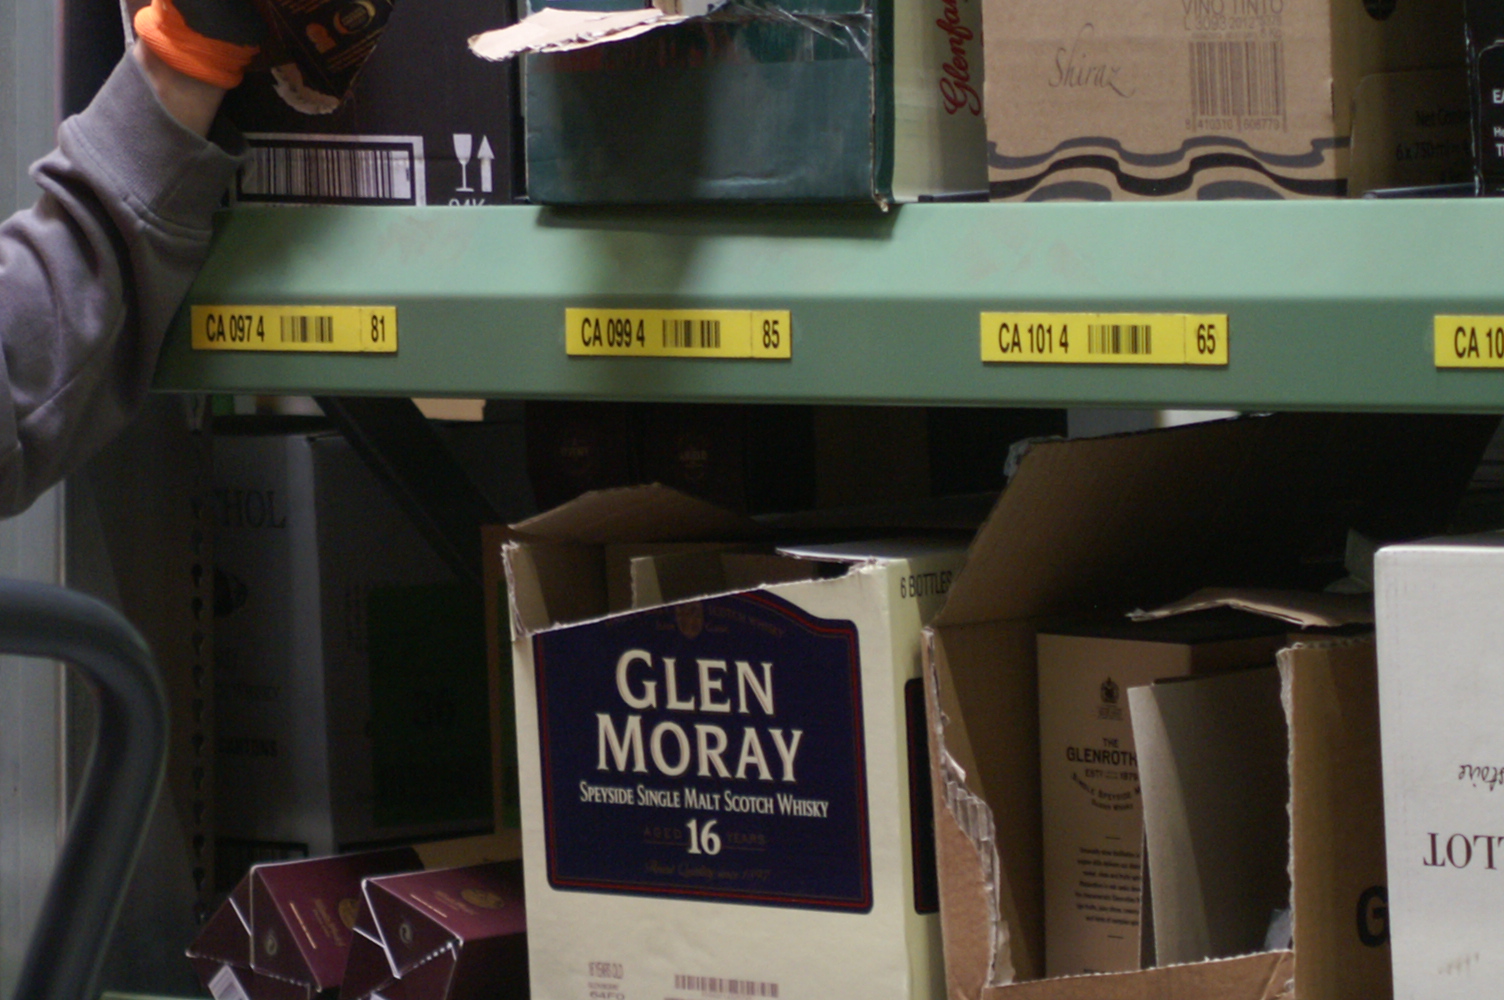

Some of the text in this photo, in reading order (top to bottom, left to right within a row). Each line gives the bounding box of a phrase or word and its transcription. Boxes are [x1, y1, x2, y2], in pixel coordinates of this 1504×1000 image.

[1048, 22, 1136, 98] Shiraz
[205, 314, 265, 343] CA 097 4
[371, 314, 386, 343] 81
[581, 317, 645, 348] CA 099 4
[763, 319, 780, 349] 85
[998, 323, 1069, 354] CA 101 4
[1196, 324, 1215, 354] 65
[1454, 326, 1480, 359] CA
[900, 570, 953, 598] 6 BOTTLES
[615, 649, 775, 715] GLEN
[596, 713, 803, 782] MORAY
[1102, 738, 1119, 748] THE
[579, 780, 829, 818] SPEYSIDE SINGLE MALT SCOTCH WHISKY
[686, 818, 722, 855] 16
[1424, 831, 1504, 869] LOT
